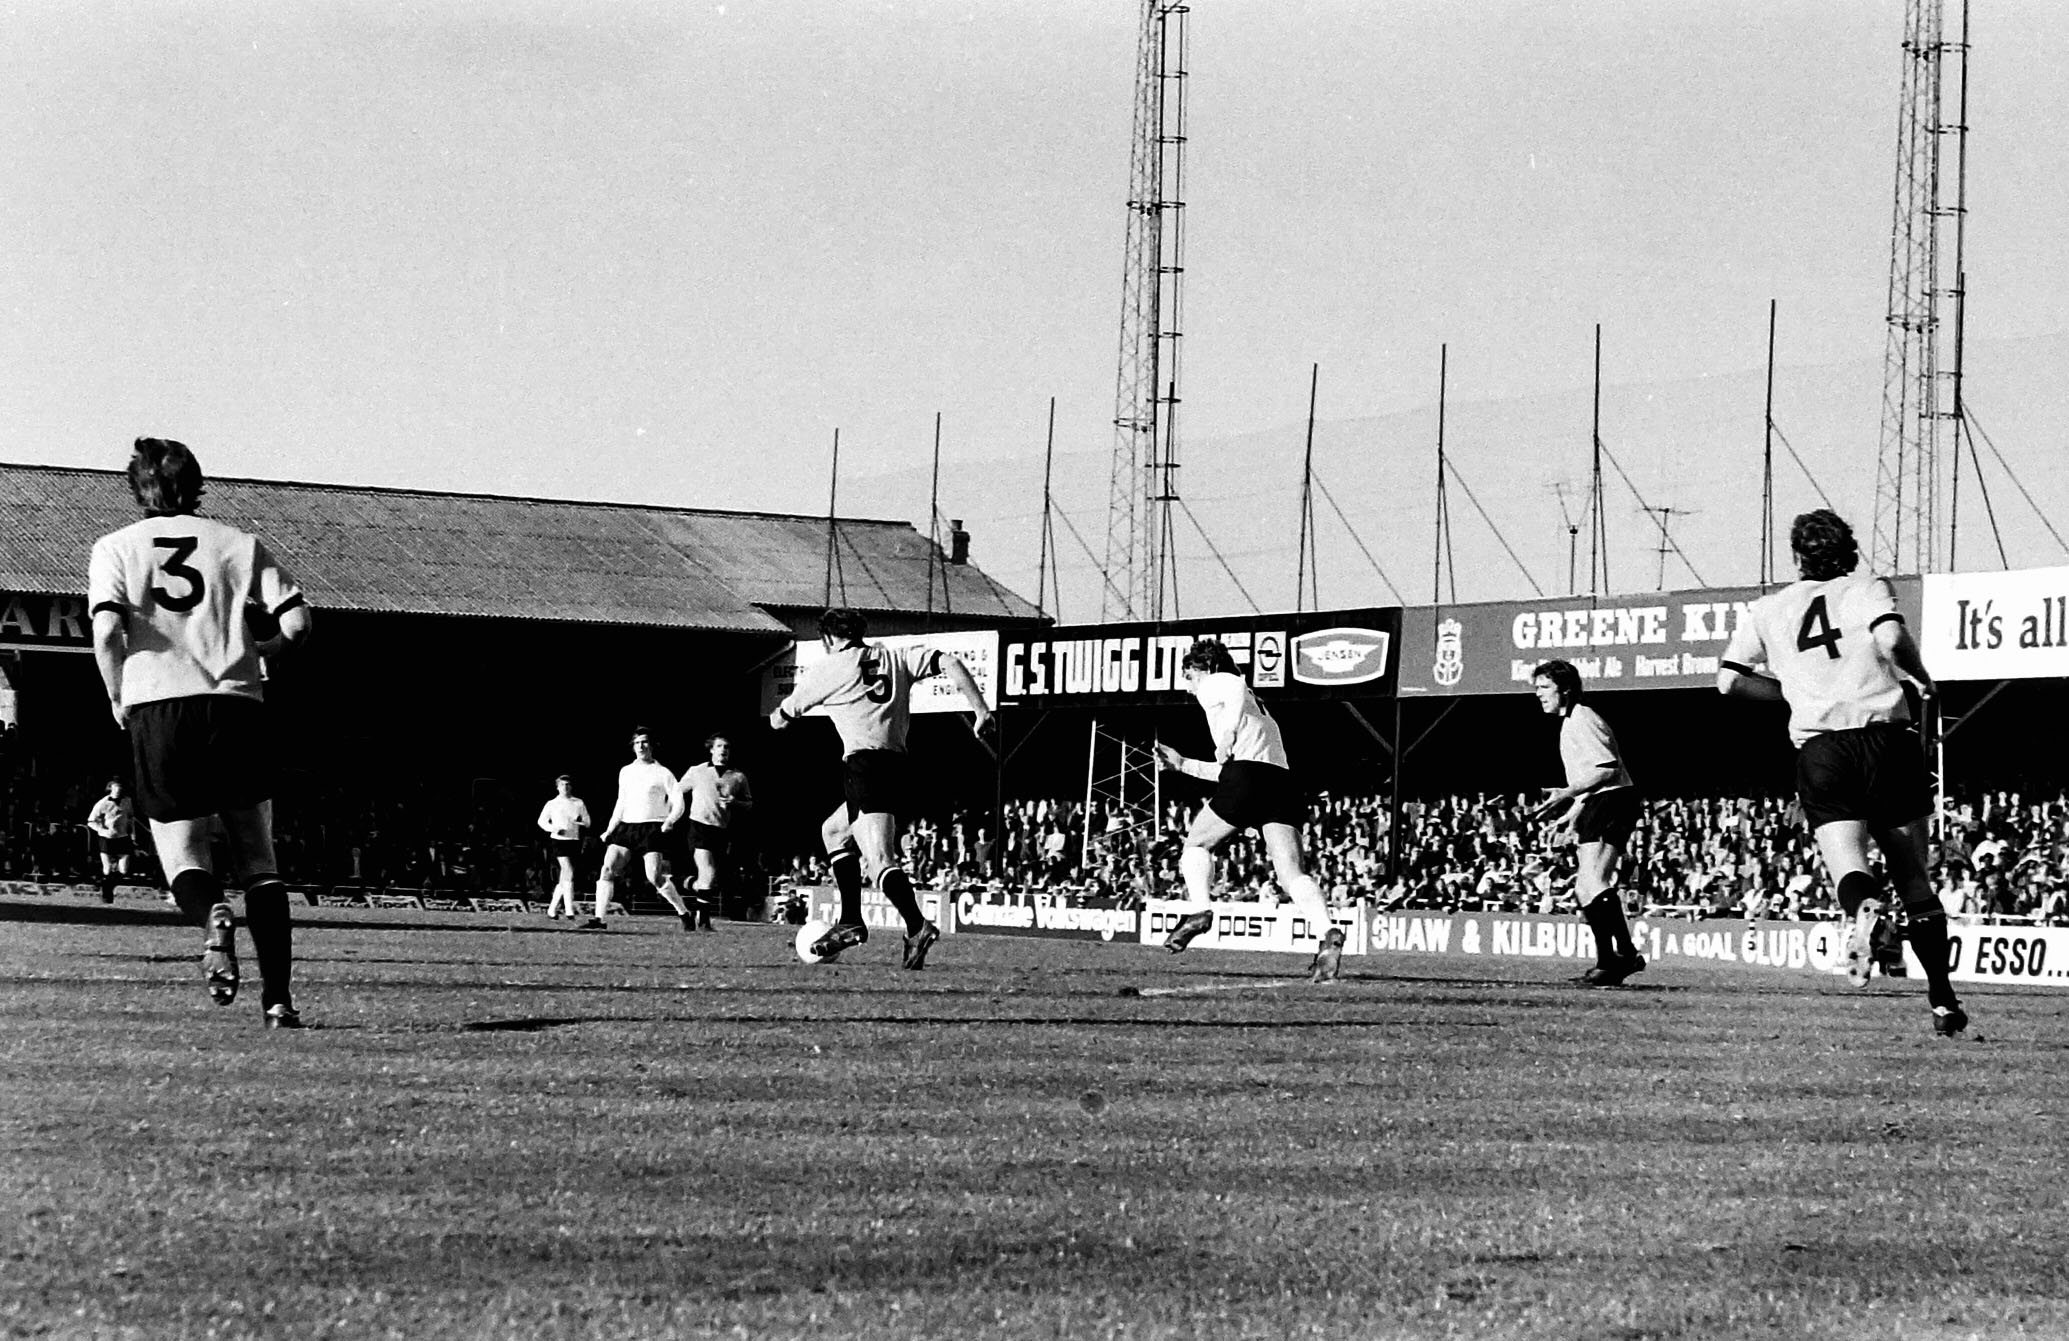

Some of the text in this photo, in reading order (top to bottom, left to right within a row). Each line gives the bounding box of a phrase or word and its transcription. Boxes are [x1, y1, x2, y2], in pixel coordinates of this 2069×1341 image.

[150, 536, 205, 613] 3
[1512, 601, 1760, 649] GREENE KIN
[1797, 595, 1842, 659] 4
[1955, 596, 2068, 651] It's all
[861, 659, 894, 704] 5
[1006, 642, 1049, 696] G.S.
[1052, 637, 1140, 694] TWIGG
[1034, 893, 1137, 941] Volkswagen
[1371, 914, 1451, 952] SHAW
[1462, 919, 1481, 954] &
[1493, 920, 1603, 959] KILBUR
[1665, 933, 1679, 955] A
[1682, 931, 1737, 961] GOAL
[1742, 927, 1806, 969] CLUB
